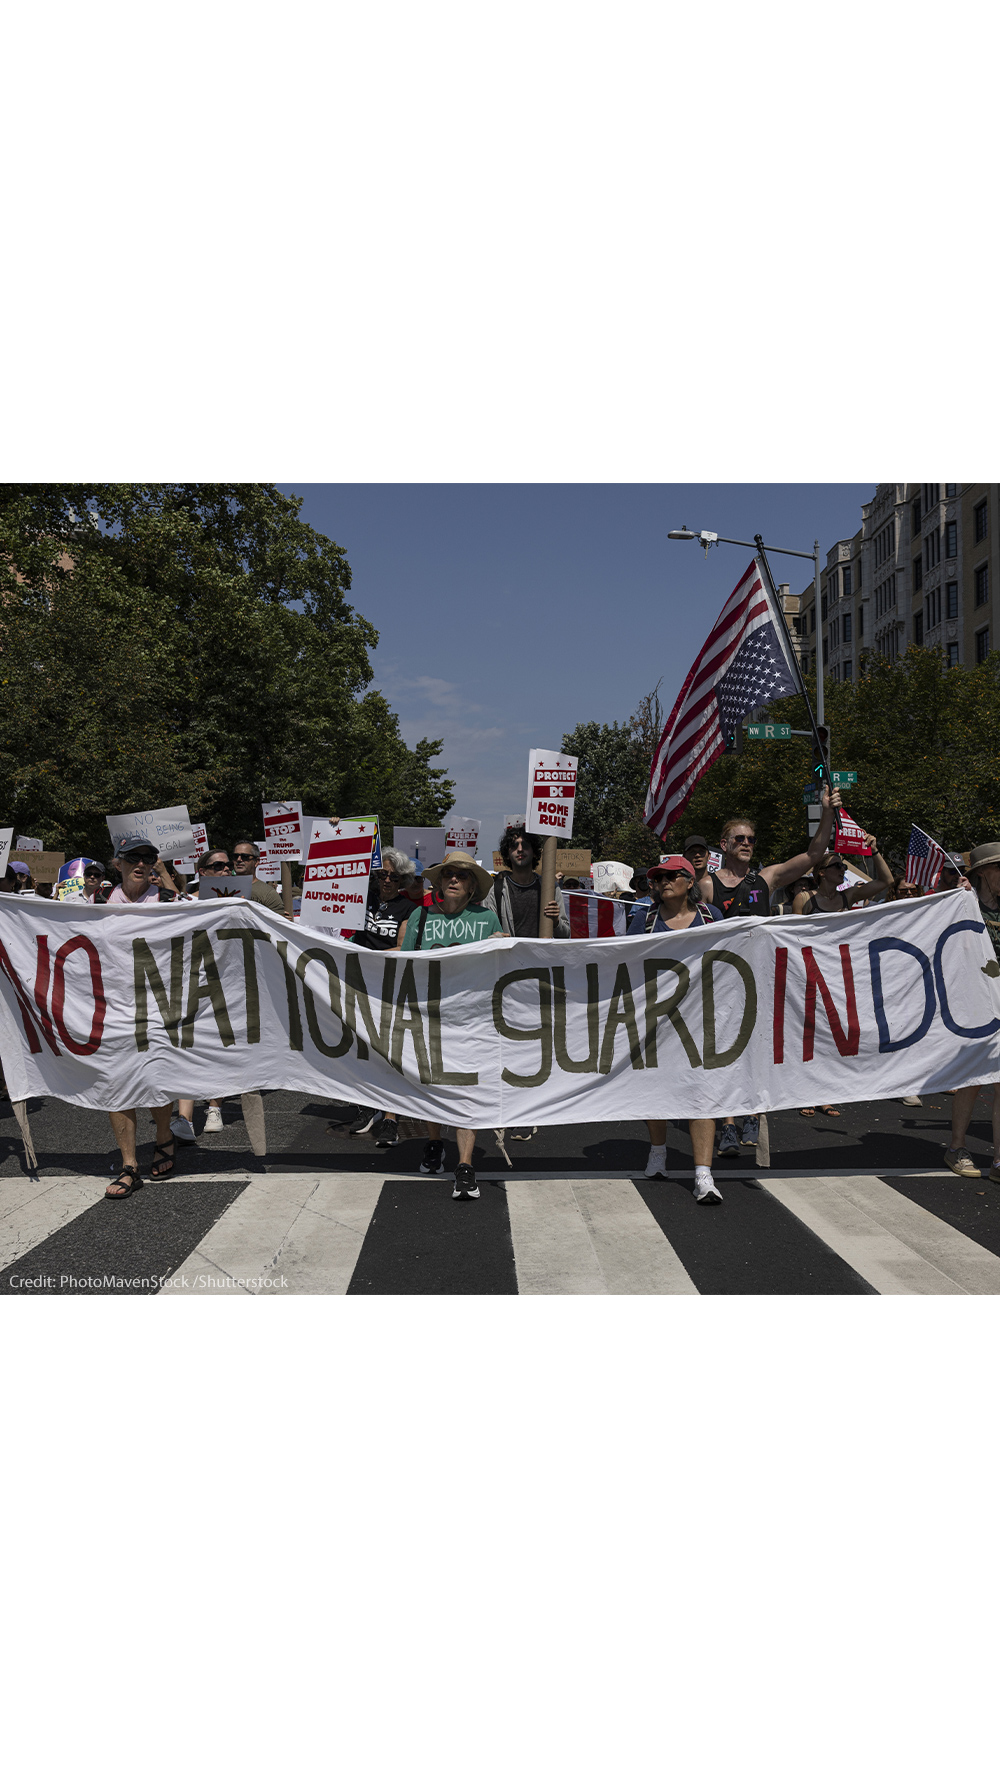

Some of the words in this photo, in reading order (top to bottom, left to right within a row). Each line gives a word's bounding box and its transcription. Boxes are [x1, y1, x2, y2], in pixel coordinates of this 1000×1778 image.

[749, 726, 759, 735] NW
[765, 725, 775, 738] R
[780, 727, 789, 736] ST
[536, 771, 576, 781] PROTECT
[833, 772, 841, 782] R
[550, 786, 563, 797] DC
[537, 801, 569, 817] HOME
[134, 813, 154, 826] NO
[539, 813, 566, 828] RULE
[156, 822, 185, 836] BEING
[269, 824, 296, 837] STOP
[159, 840, 186, 853] EGAL
[308, 861, 367, 879] PROTEJA
[597, 864, 614, 877] DC
[66, 878, 80, 888] REE
[304, 891, 364, 904] AUTONOMÍA
[332, 904, 346, 914] DC
[366, 921, 378, 933] EE
[379, 927, 397, 938] DC
[0, 934, 106, 1056] NO
[132, 927, 479, 1085] NATIONAL
[773, 943, 860, 1065] IN
[868, 919, 1000, 1053] DC
